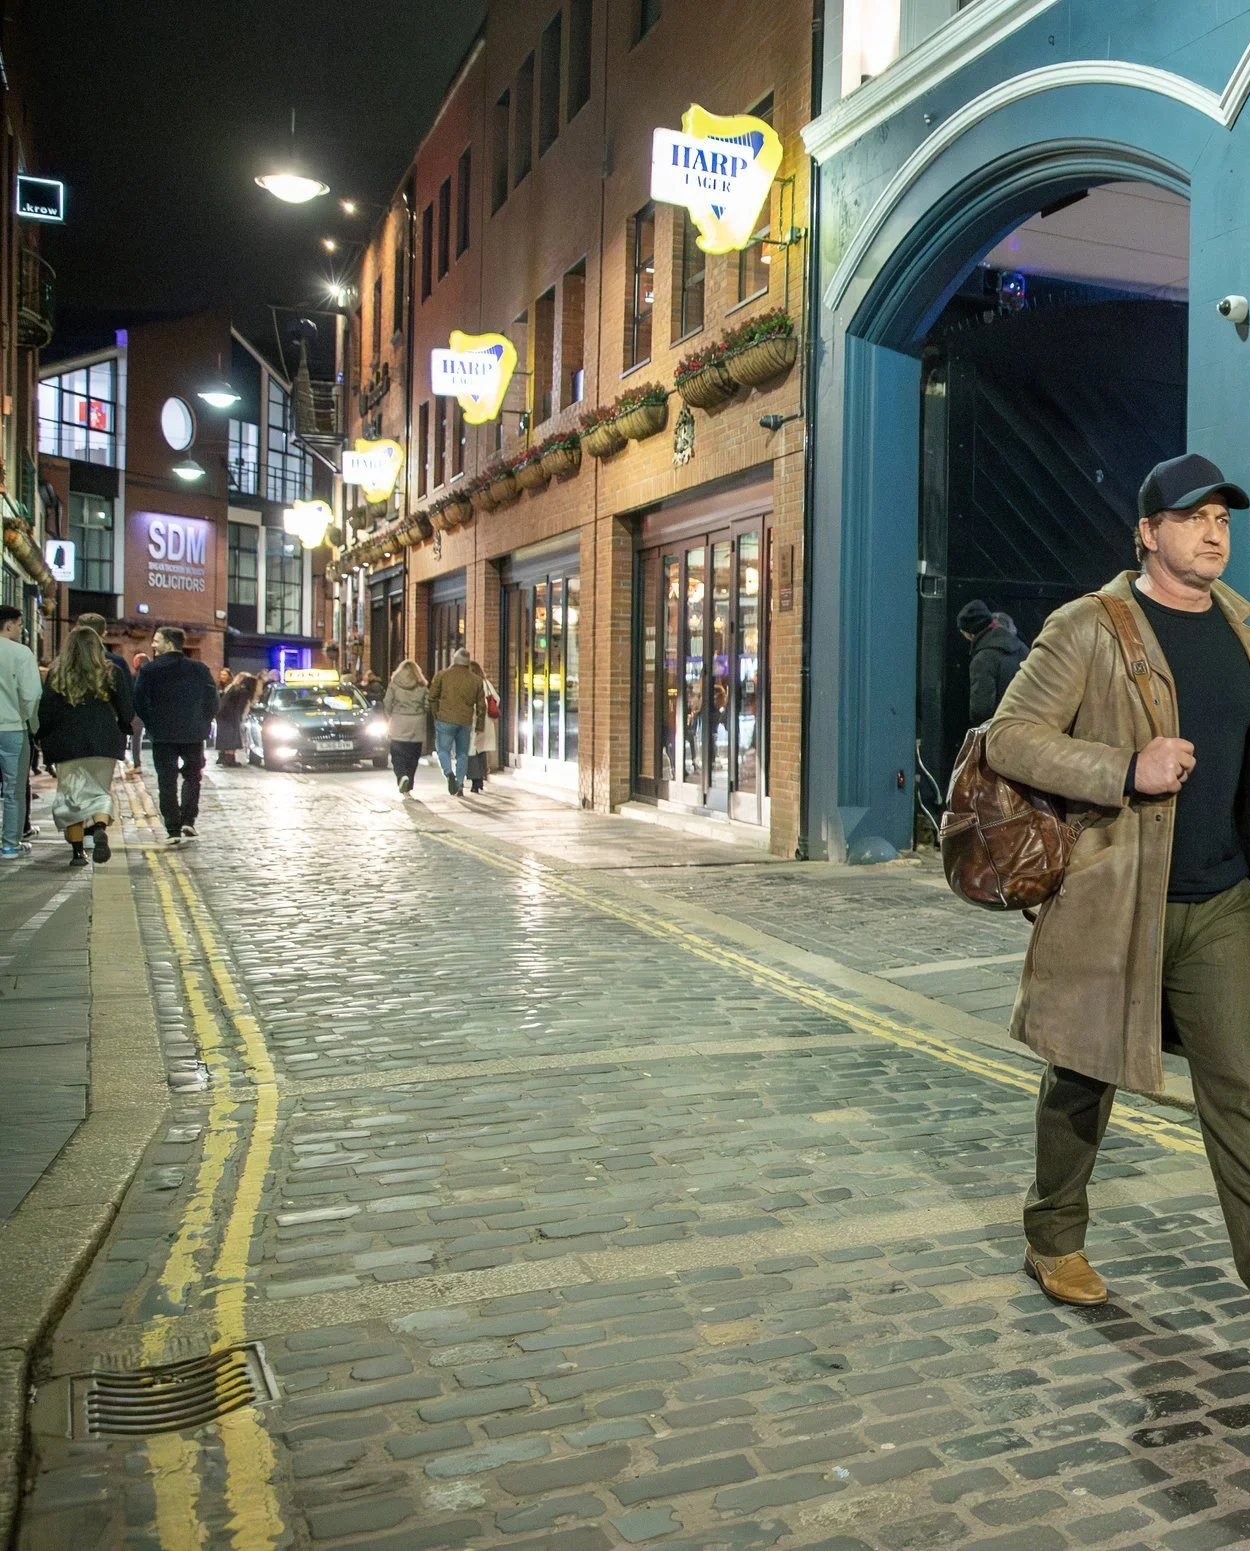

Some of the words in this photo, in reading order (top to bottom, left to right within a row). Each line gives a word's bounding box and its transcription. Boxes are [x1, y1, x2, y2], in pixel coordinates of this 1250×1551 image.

[671, 143, 748, 178] HARP
[22, 203, 58, 216] .krow
[442, 359, 493, 376] HARP
[148, 520, 206, 565] SDM
[148, 572, 206, 593] SOLICITORS
